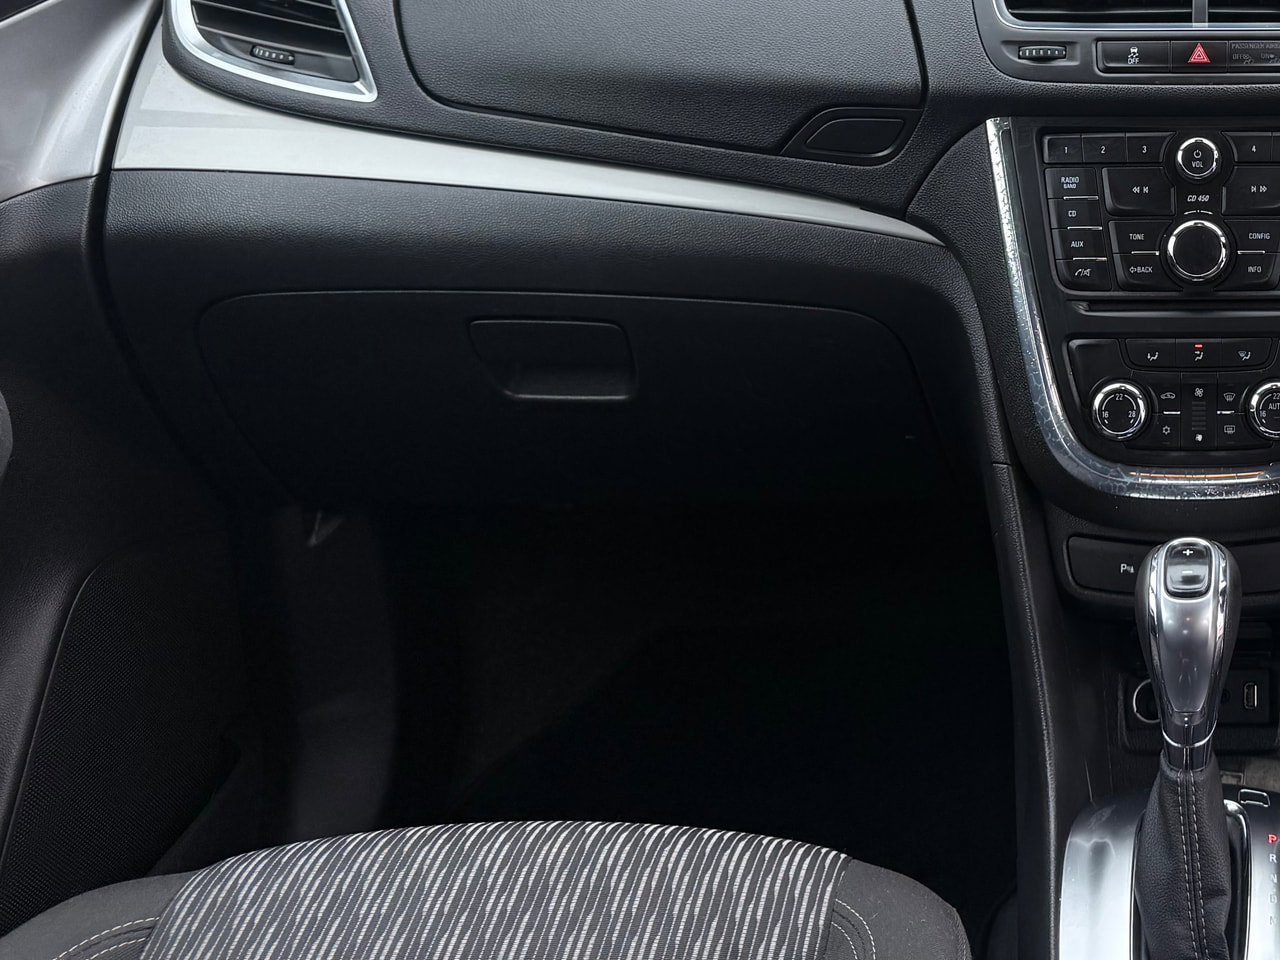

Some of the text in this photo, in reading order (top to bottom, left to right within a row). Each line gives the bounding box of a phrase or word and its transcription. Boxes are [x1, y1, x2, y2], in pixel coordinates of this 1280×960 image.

[1272, 392, 1280, 400] 22
[1128, 410, 1136, 418] 28
[1268, 834, 1278, 844] P
[1269, 853, 1277, 863] R
